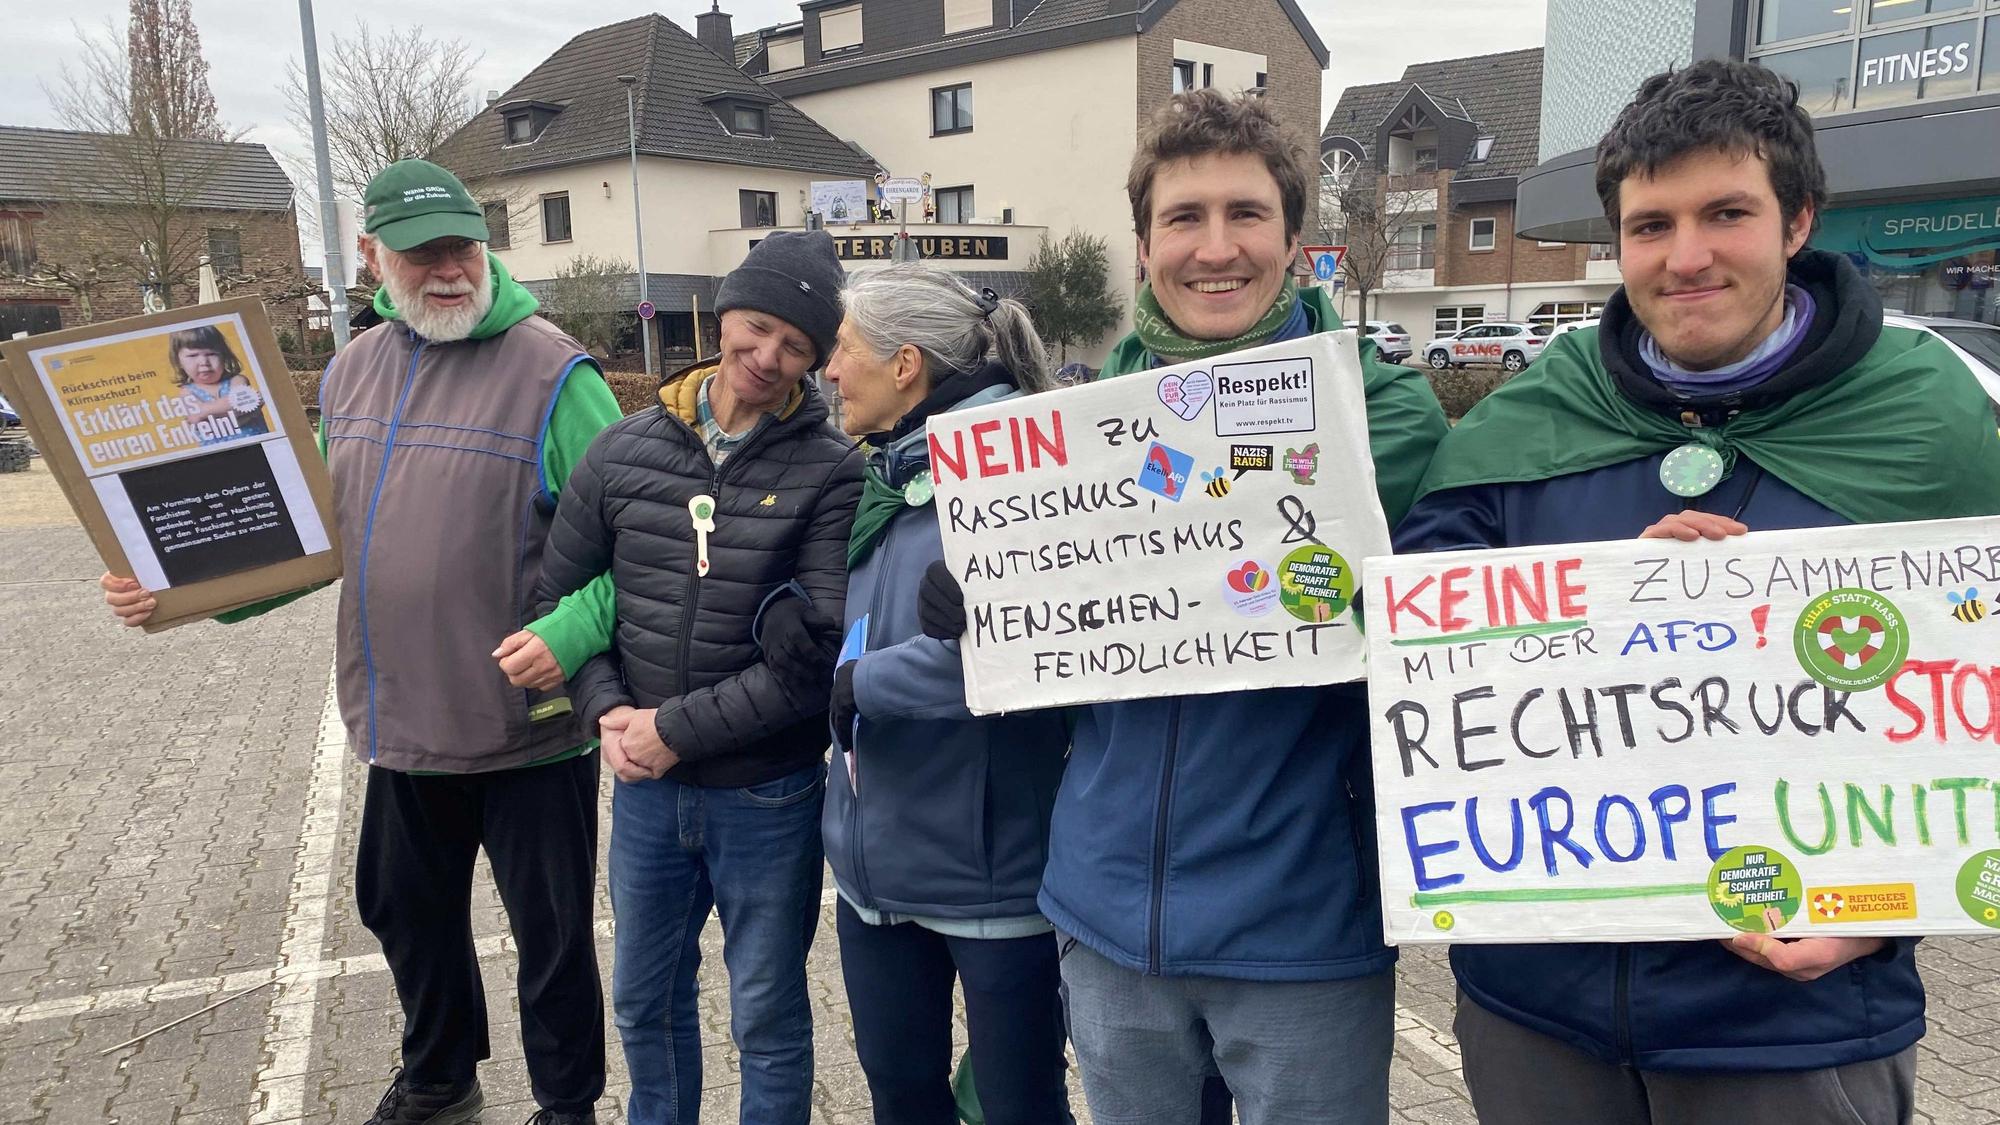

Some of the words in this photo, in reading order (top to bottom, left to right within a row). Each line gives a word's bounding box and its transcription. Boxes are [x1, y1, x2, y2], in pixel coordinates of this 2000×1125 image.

[1862, 42, 1970, 87] FITNESS
[1946, 266, 1964, 275] WIR
[61, 374, 126, 395] Rückschritt
[128, 369, 157, 382] beim
[1218, 370, 1307, 396] Respekt!
[67, 385, 141, 407] Klimaschutz?
[1237, 399, 1255, 407] Platz
[1257, 398, 1267, 406] für
[1269, 396, 1308, 405] Rassismus
[74, 399, 155, 437] Erklärt
[156, 394, 199, 421] das
[1236, 417, 1294, 427] www.respekt.tv
[88, 431, 156, 462] euren
[156, 410, 242, 448] Enkeln!
[927, 409, 1069, 486] NEIN
[1233, 446, 1268, 457] NAZIS
[1233, 457, 1267, 467] RAUS!
[204, 491, 220, 501] den
[949, 477, 1158, 535] RASSISMUS,
[176, 529, 192, 539] den
[964, 519, 1245, 583] ANTISEMITISMUS
[1276, 495, 1327, 547] &
[1313, 553, 1330, 564] NUR
[1289, 563, 1339, 577] DEMOKRATIE.
[1295, 574, 1329, 586] SCHAFFT
[1304, 587, 1338, 599] FREIHEIT.
[1384, 558, 1589, 635] KEINE
[974, 587, 1202, 648] MENSCHEN-
[1803, 598, 1832, 629] HILFE
[1832, 593, 1872, 605] STATT
[1033, 622, 1347, 685] FEINDLICHKEIT
[1403, 642, 1488, 684] MIT
[1510, 627, 1599, 664] DER
[1383, 675, 1867, 778] RECHTSRUCK
[1400, 781, 1739, 892] EUROPE
[1746, 853, 1765, 865] NUR
[1720, 865, 1779, 881] DEMOKRATIE.
[1731, 879, 1771, 892] SCHAFFT
[1745, 890, 1786, 904] FREIHEIT.
[1849, 892, 1906, 903] REFUGEES
[1849, 902, 1909, 913] WELCOME
